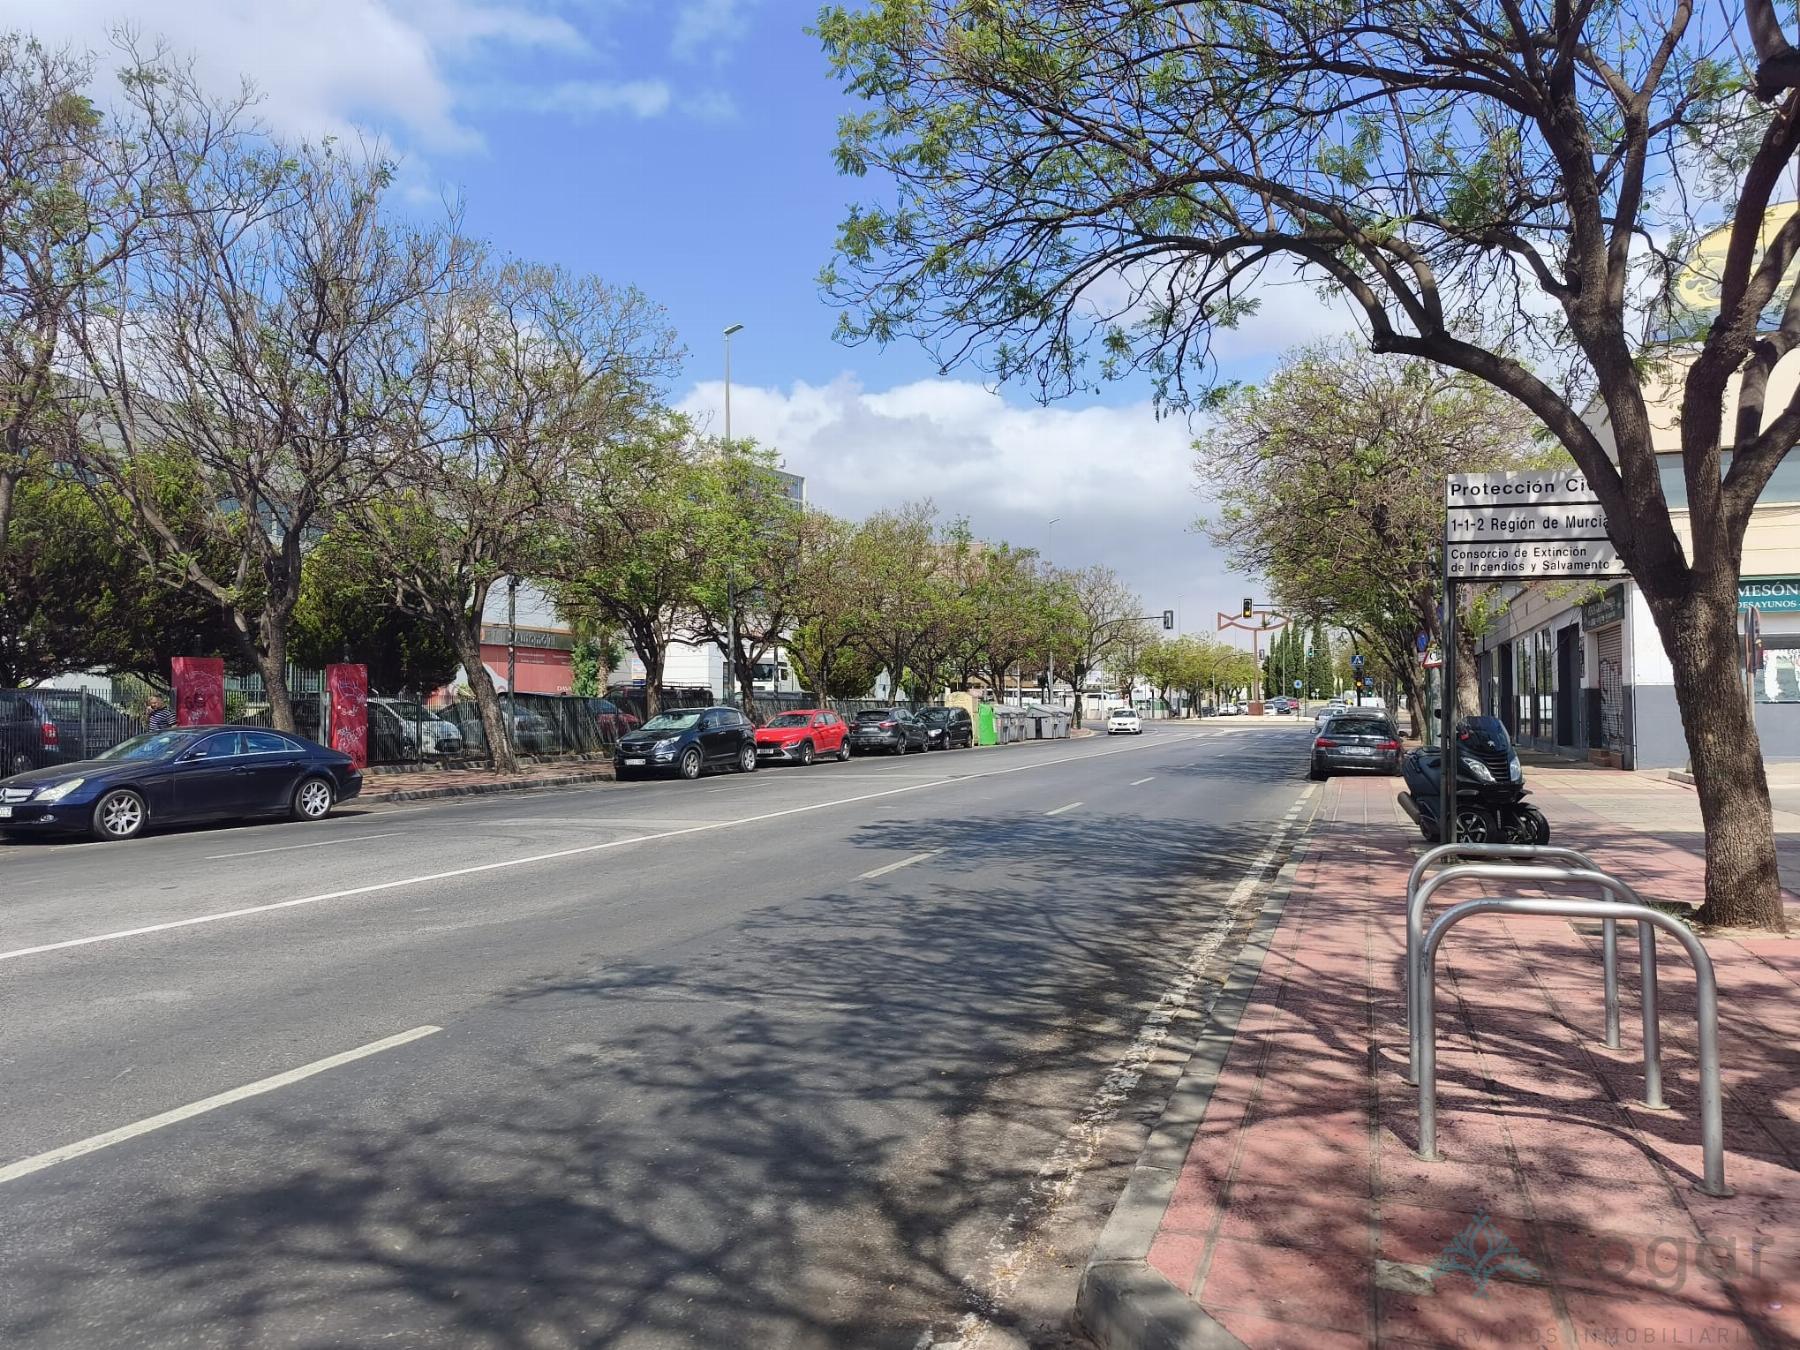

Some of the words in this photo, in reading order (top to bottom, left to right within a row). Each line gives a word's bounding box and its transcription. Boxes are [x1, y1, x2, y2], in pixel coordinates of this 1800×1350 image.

[1451, 480, 1554, 496] Protección
[1451, 518, 1484, 531] 1-1-2
[1491, 516, 1535, 532] Región
[1542, 516, 1558, 529] de
[1565, 513, 1609, 529] Murcia
[1451, 548, 1508, 560] Consorcio
[1514, 547, 1528, 558] de
[1533, 546, 1586, 557] Extinción
[1451, 561, 1465, 572] de
[1470, 560, 1525, 571] Incendios
[1531, 562, 1537, 573] y
[1542, 560, 1609, 571] Salvamento
[1738, 581, 1799, 597] MESÓN
